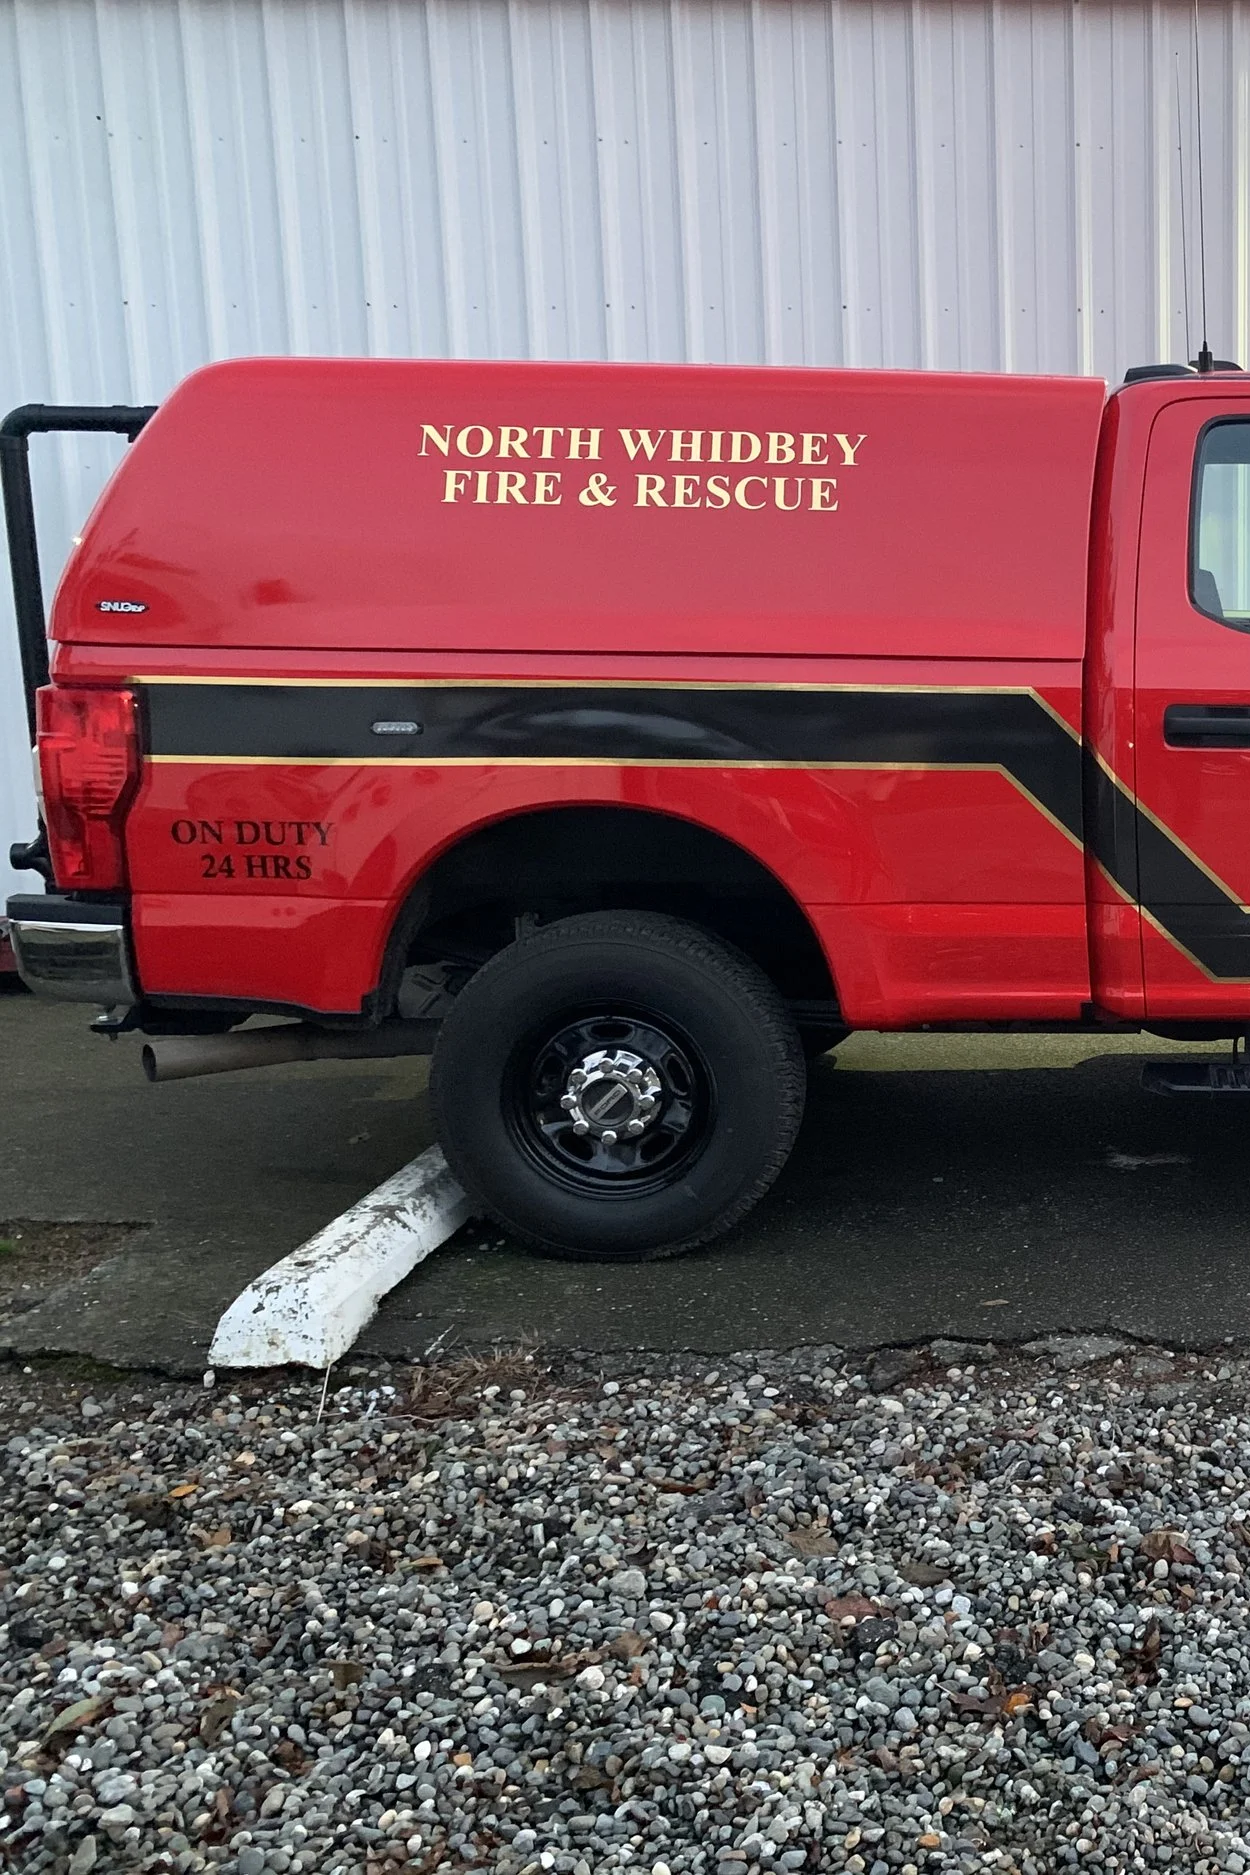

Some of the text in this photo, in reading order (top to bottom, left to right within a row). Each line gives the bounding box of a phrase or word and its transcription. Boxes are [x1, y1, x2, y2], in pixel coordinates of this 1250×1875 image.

[418, 424, 868, 466] NORTH WHIDBEY
[440, 470, 839, 512] FIRE & RESCUE
[171, 819, 334, 846] ON DUTY
[201, 854, 312, 880] 24 HRS
[593, 1089, 621, 1116] FORD
